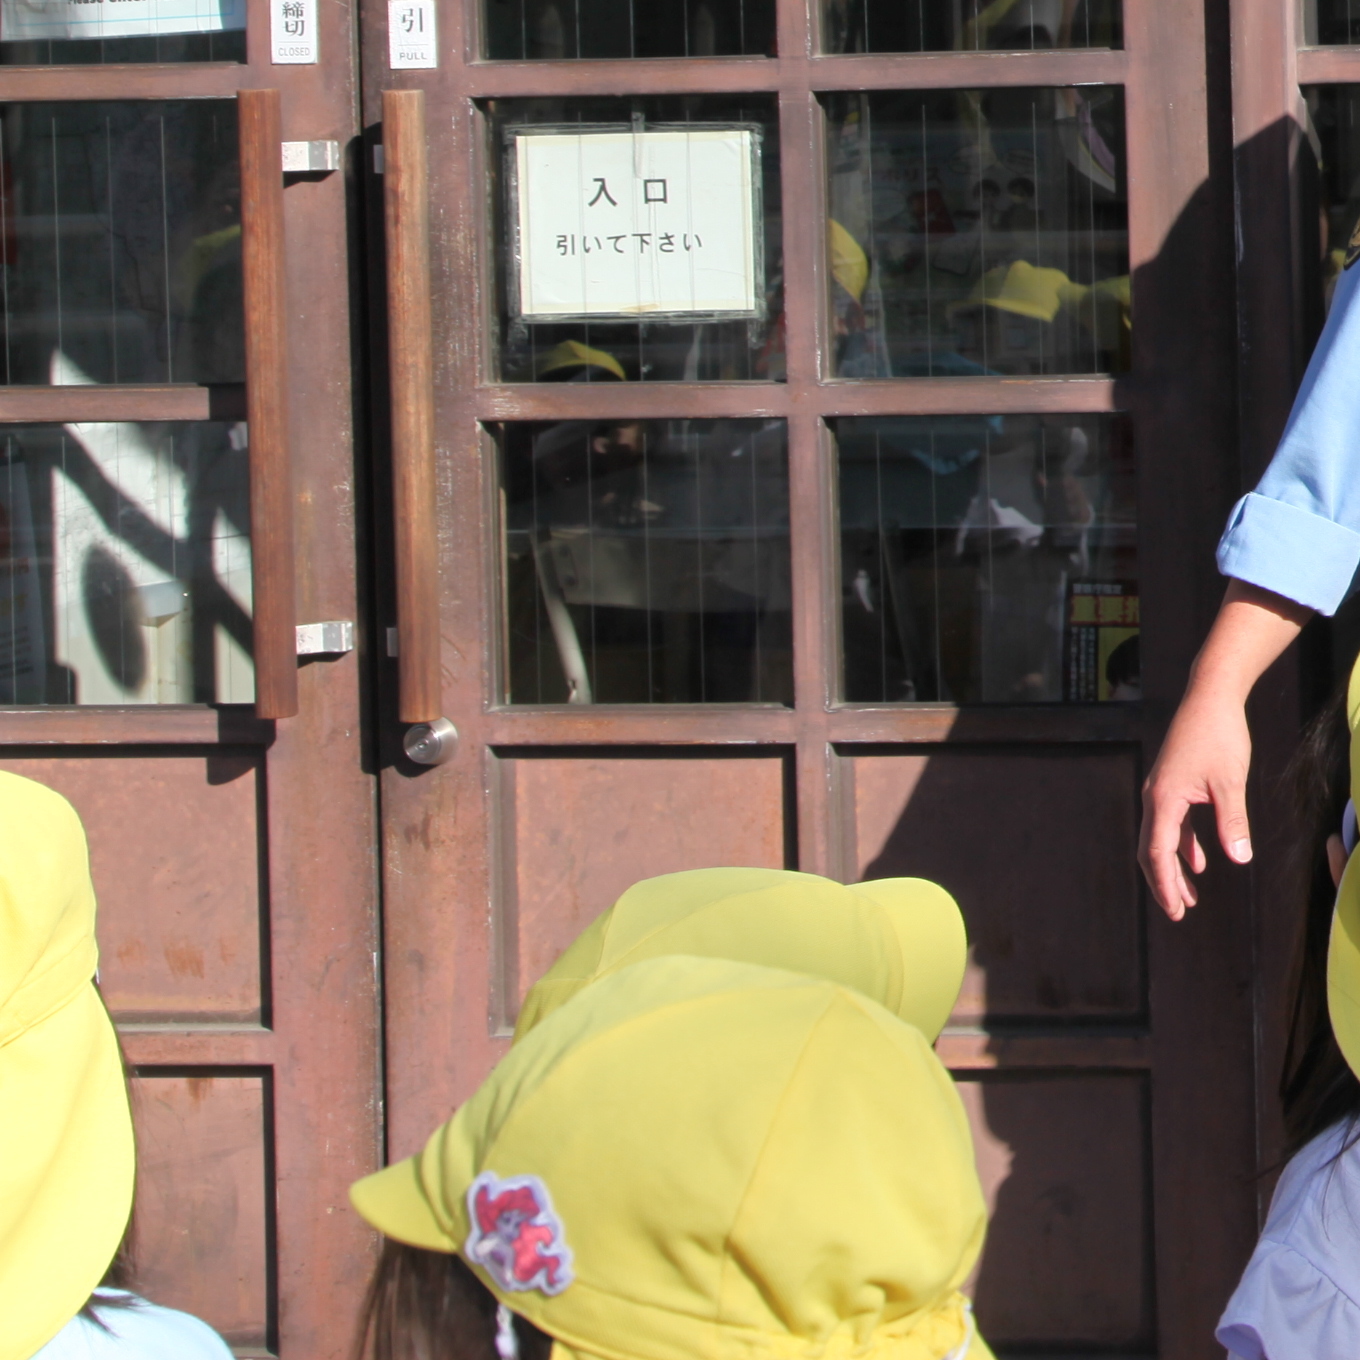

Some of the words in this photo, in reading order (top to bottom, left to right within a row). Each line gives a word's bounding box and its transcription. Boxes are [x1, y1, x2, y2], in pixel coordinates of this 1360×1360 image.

[282, 1, 304, 37] 締切
[401, 7, 424, 33] 引
[278, 47, 310, 57] CLOSED
[399, 52, 427, 61] PULL
[588, 177, 668, 207] 入口
[556, 232, 702, 255] 引いて下さい
